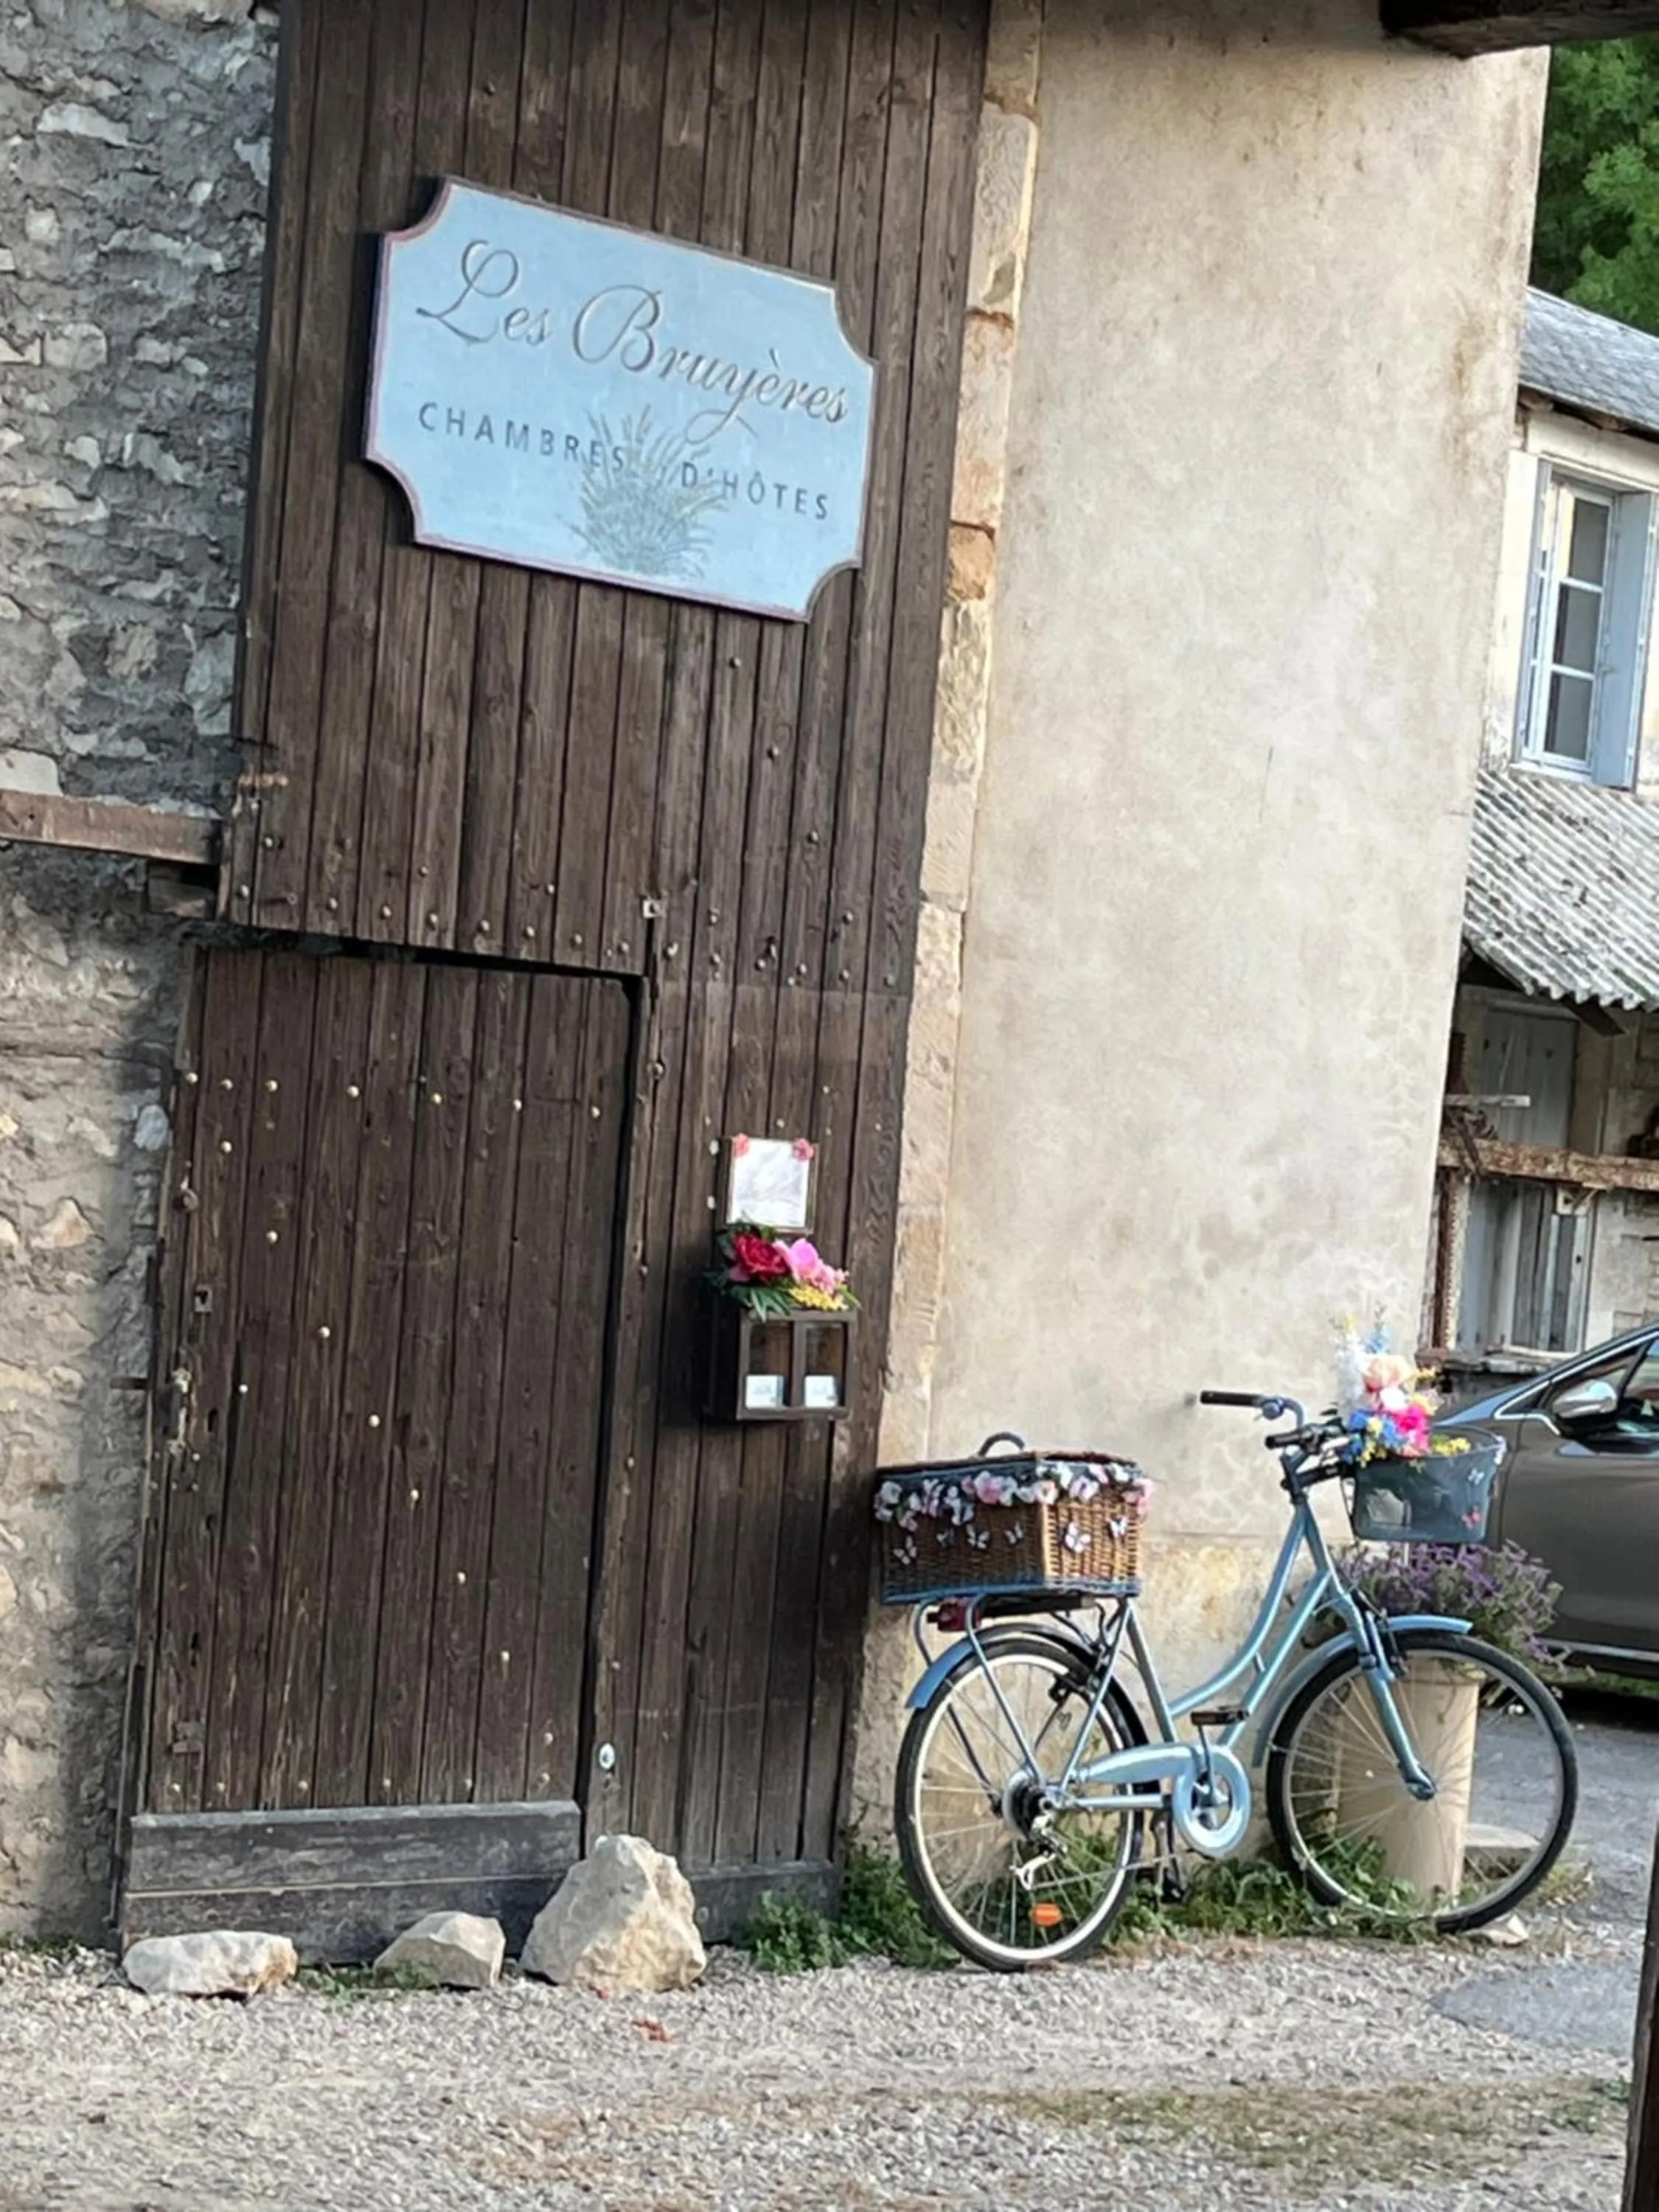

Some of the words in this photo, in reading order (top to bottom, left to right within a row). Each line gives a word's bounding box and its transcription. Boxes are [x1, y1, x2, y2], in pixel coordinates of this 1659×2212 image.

[417, 240, 551, 345] Les
[573, 285, 849, 444] Bruyères
[419, 402, 625, 470] CHAMBRES
[681, 461, 829, 519] D'HÔTES
